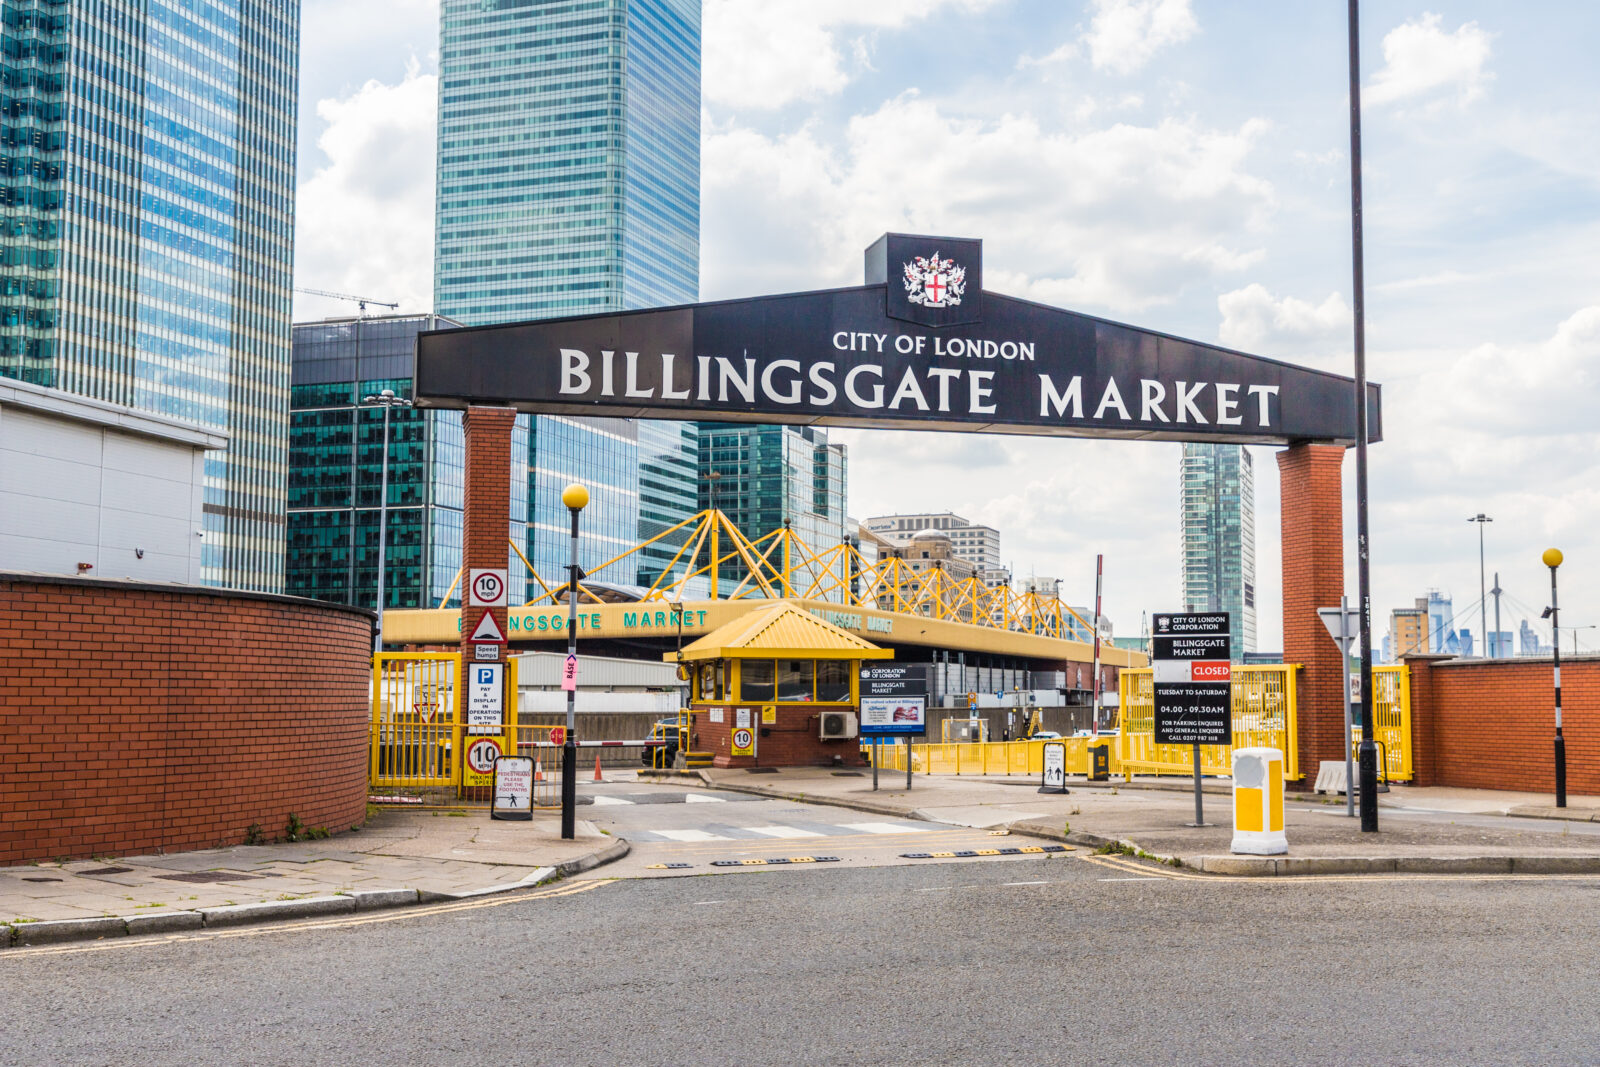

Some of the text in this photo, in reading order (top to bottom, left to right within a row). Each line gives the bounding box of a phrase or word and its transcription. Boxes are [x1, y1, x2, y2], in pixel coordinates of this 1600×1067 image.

[833, 332, 1036, 361] CITY OF LONDON
[559, 348, 1280, 427] BILLINGSGATE MARKET
[480, 578, 496, 591] 10
[623, 610, 708, 628] MARKET
[1172, 639, 1225, 647] BILLINGSGATE
[1173, 648, 1206, 656] MARKET
[566, 662, 575, 679] BASE
[1193, 666, 1229, 676] CLOSED
[737, 733, 749, 743] 10
[474, 746, 496, 762] 10
